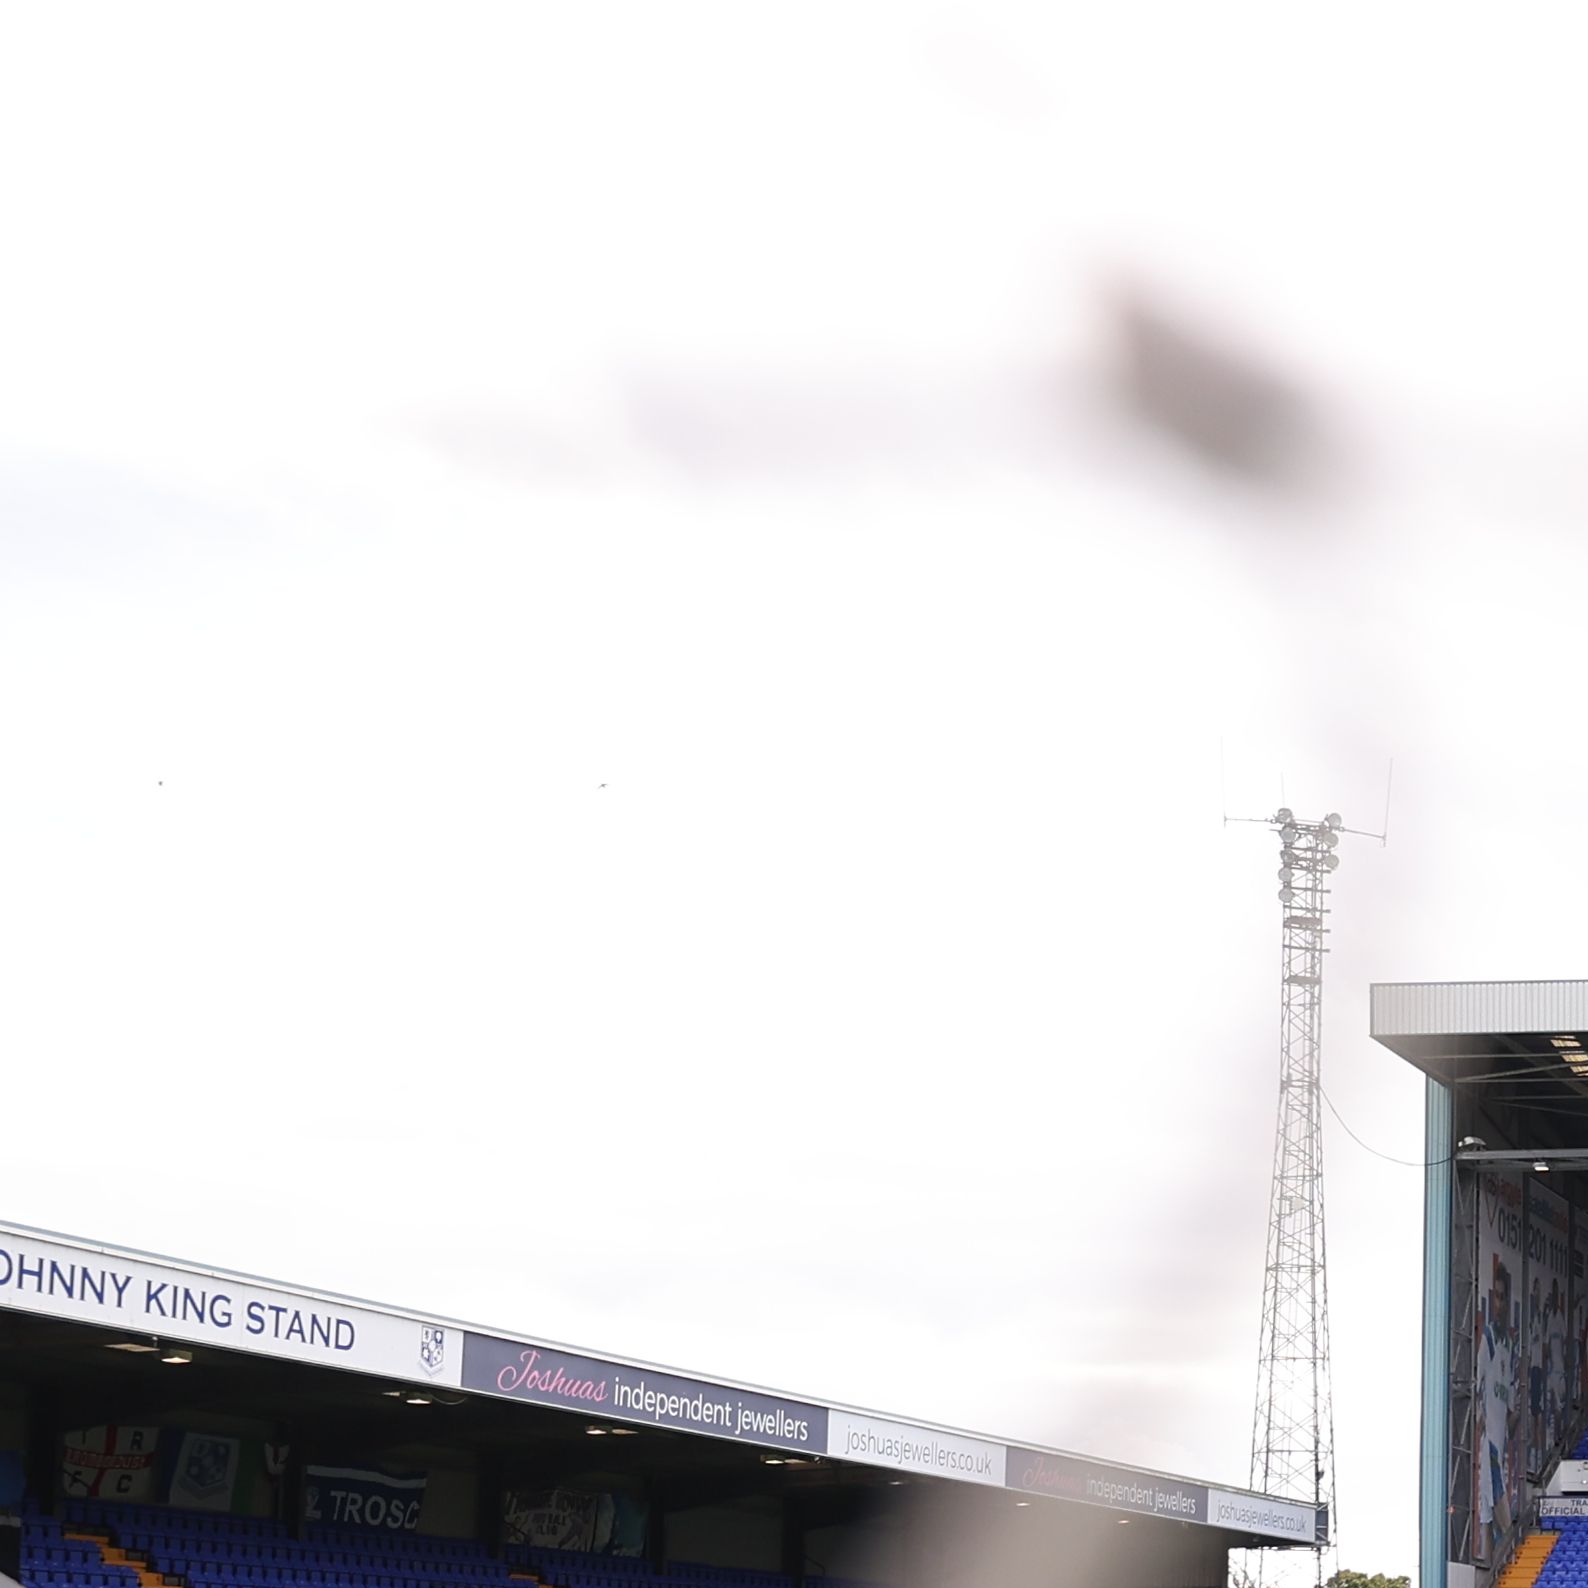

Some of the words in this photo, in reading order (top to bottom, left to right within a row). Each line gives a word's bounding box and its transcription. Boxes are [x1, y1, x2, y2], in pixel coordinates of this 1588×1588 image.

[144, 1280, 232, 1328] KING
[246, 1302, 355, 1350] STAND
[497, 1350, 608, 1402] Joshuas
[614, 1377, 732, 1427] independent
[735, 1402, 808, 1441] jewellers
[844, 1424, 993, 1477] joshuasjewellers.co.uk
[329, 1490, 420, 1531] TROSC
[1086, 1474, 1153, 1508] independent
[1153, 1486, 1196, 1515] jewellers
[1542, 1507, 1584, 1515] OFFICIAL
[1216, 1499, 1307, 1533] joshuasjewellers.co.uk
